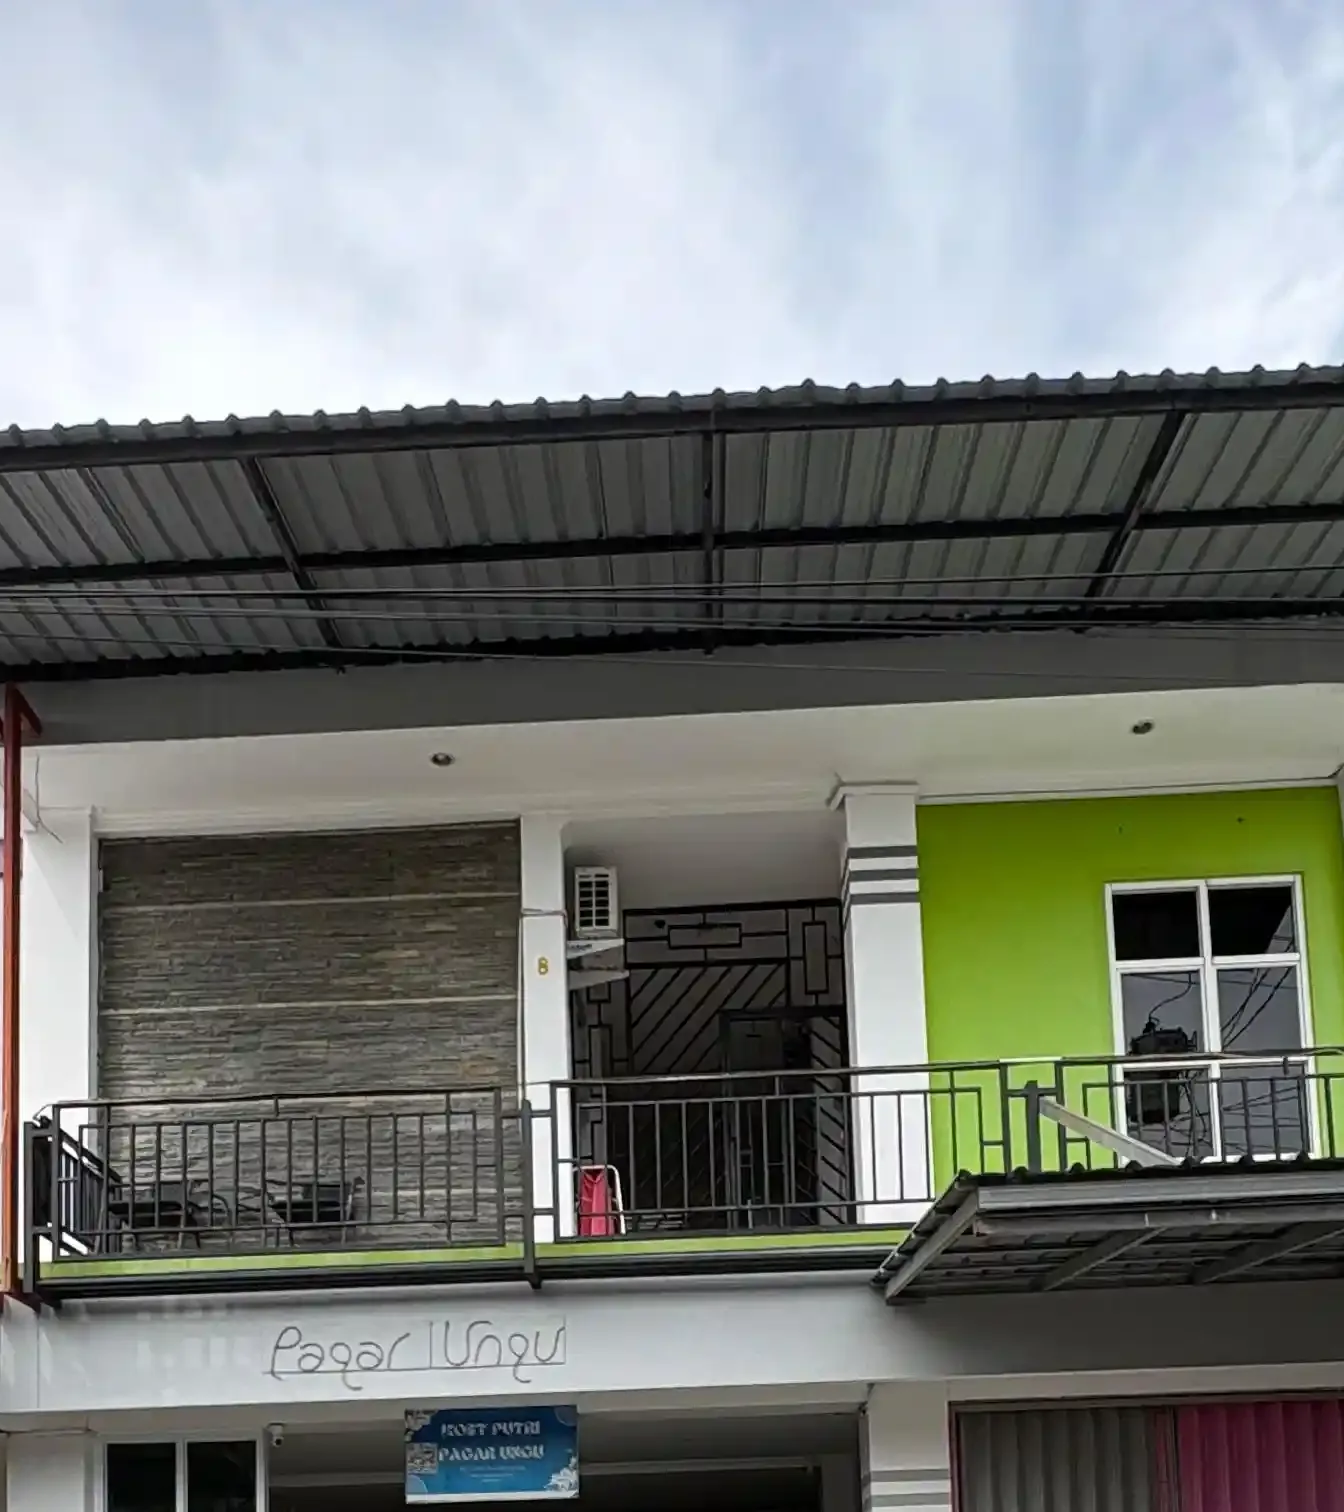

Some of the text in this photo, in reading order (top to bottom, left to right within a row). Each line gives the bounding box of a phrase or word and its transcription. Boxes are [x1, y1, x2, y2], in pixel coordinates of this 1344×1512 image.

[270, 1325, 411, 1391] Pagar
[491, 1420, 541, 1436] PUTRI
[438, 1444, 545, 1461] PAGAR UNGU
